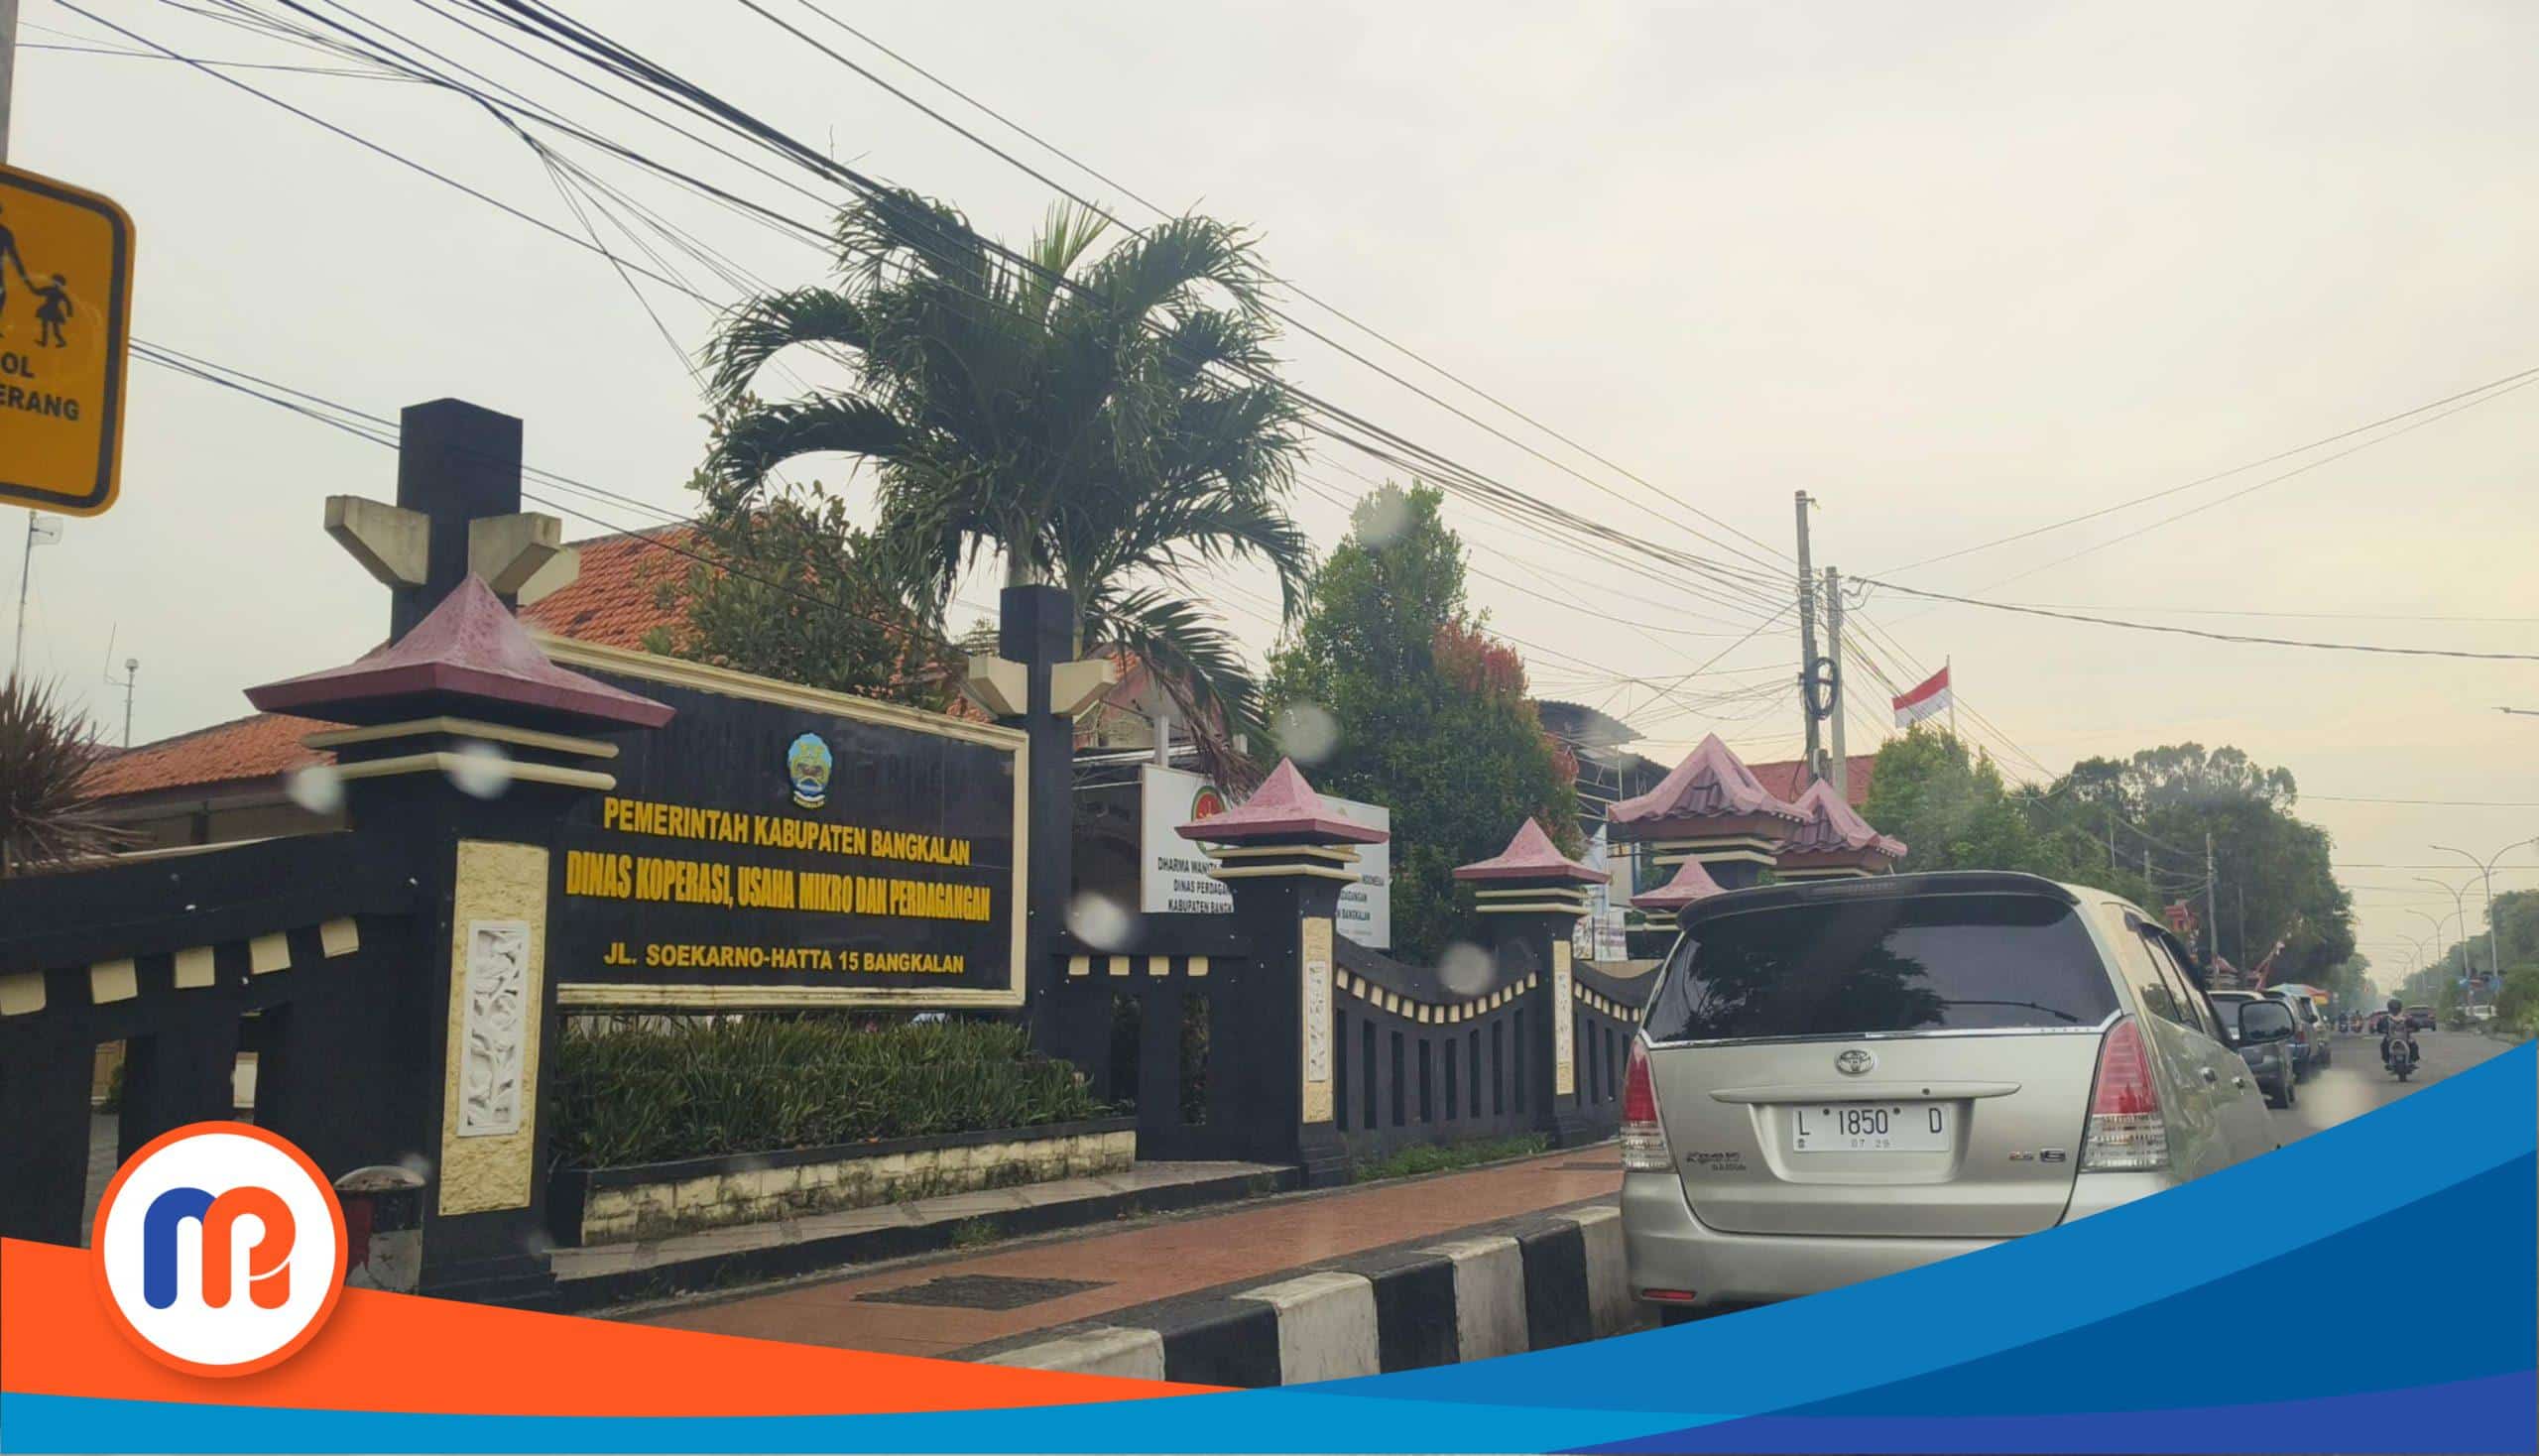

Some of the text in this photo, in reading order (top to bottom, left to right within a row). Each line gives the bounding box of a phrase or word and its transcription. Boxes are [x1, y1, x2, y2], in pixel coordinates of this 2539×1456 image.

[603, 796, 971, 866] PEMERINTAH KABUPATEN BANGKALAN
[1157, 856, 1190, 873] DHARMA
[565, 850, 991, 921] DINAS KOPERASI, USAHA MIKRO DAN PERDAGANGAN
[1173, 879, 1195, 893] DINAS
[1167, 899, 1208, 912] KABUPATEN
[603, 941, 965, 974] JL. SOEKARNO-HATTA 15 BANGKALAN
[1798, 1107, 1943, 1136] L 1850 D
